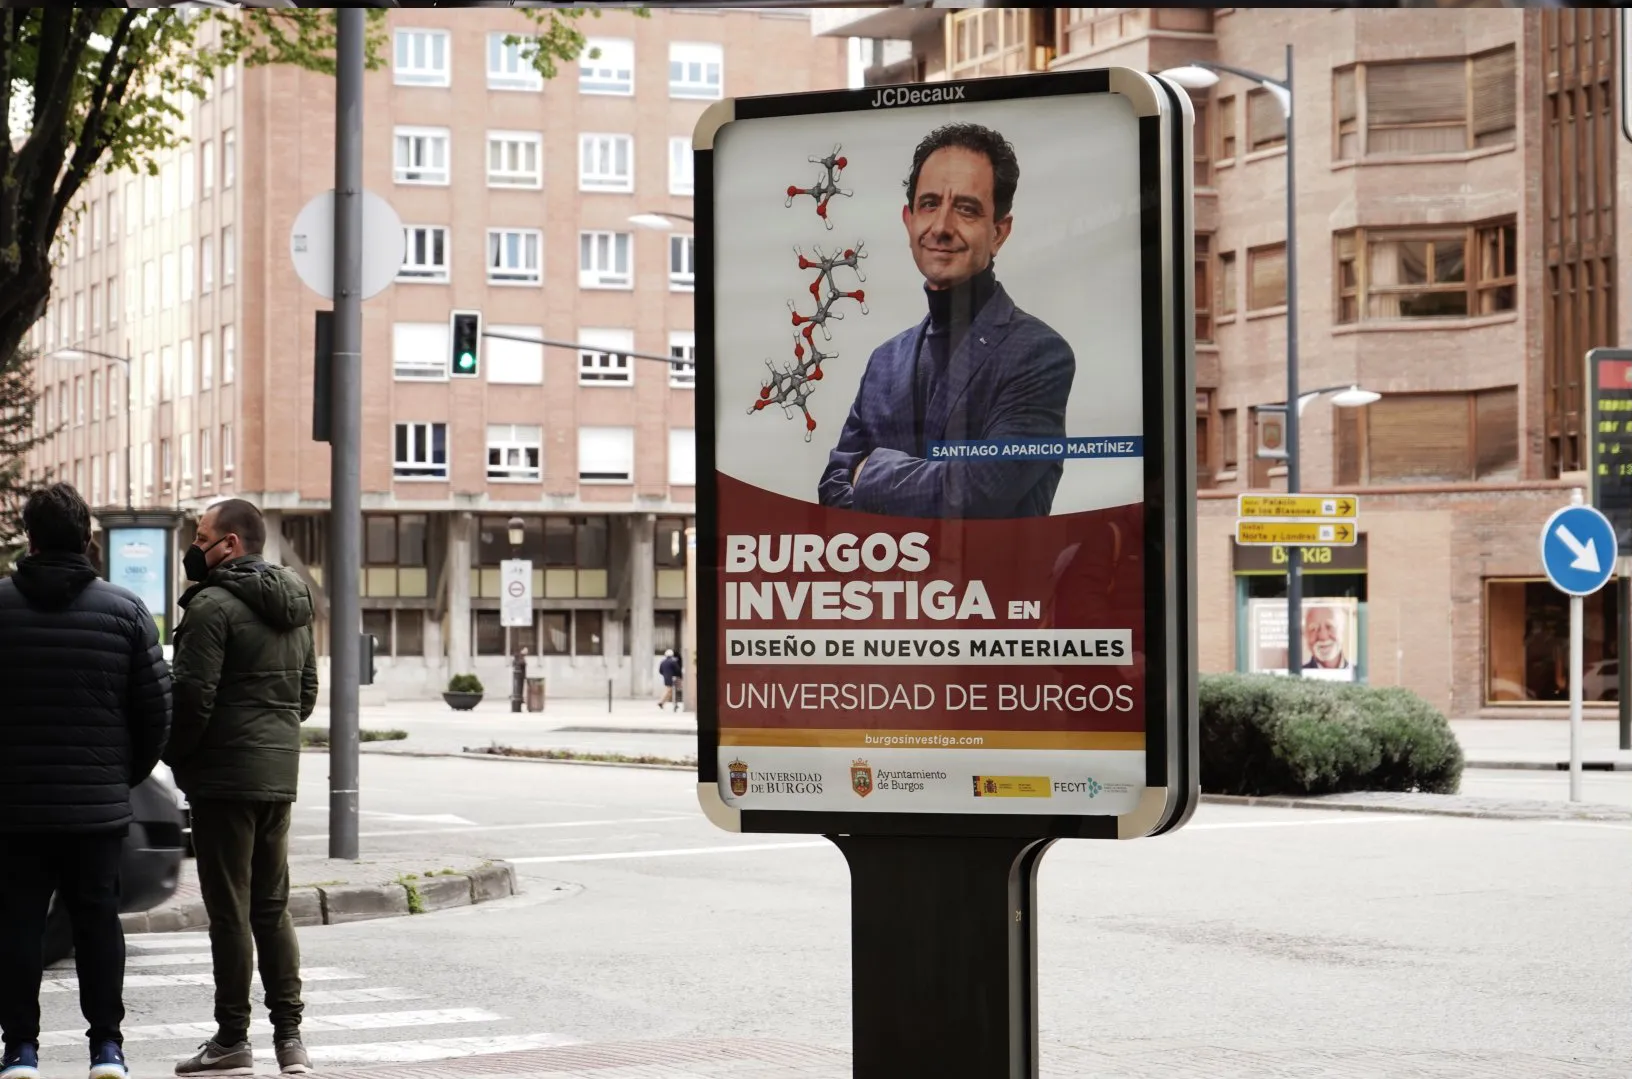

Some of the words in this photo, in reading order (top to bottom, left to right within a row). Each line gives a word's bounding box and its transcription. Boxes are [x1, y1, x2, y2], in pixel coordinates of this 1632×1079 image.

[871, 85, 965, 107] JCDecaux
[932, 444, 999, 457] SANTIAGO
[1001, 443, 1064, 456] APARICIO
[1067, 439, 1134, 454] MARTÍNEZ
[726, 532, 930, 573] BURGOS
[1272, 545, 1332, 564] Bkia
[726, 580, 995, 620] INVESTIGA
[1007, 600, 1041, 620] EN
[731, 635, 816, 657] DISEÑO
[825, 639, 855, 657] DE
[864, 639, 961, 658] NUEVOS
[970, 639, 1125, 658] MATERIALES
[727, 683, 934, 709] UNIVERSIDAD
[946, 685, 987, 710] DE
[999, 685, 1133, 711] BURGOS
[865, 734, 984, 747] burgosinvestiga.com
[750, 771, 822, 782] UNIVERSIDAD
[876, 769, 947, 782] Ayuntamiento
[751, 784, 764, 793] DE
[766, 782, 823, 794] BURGOS
[877, 779, 889, 790] de
[891, 779, 925, 793] Burgos
[1053, 782, 1087, 793] FECYT
